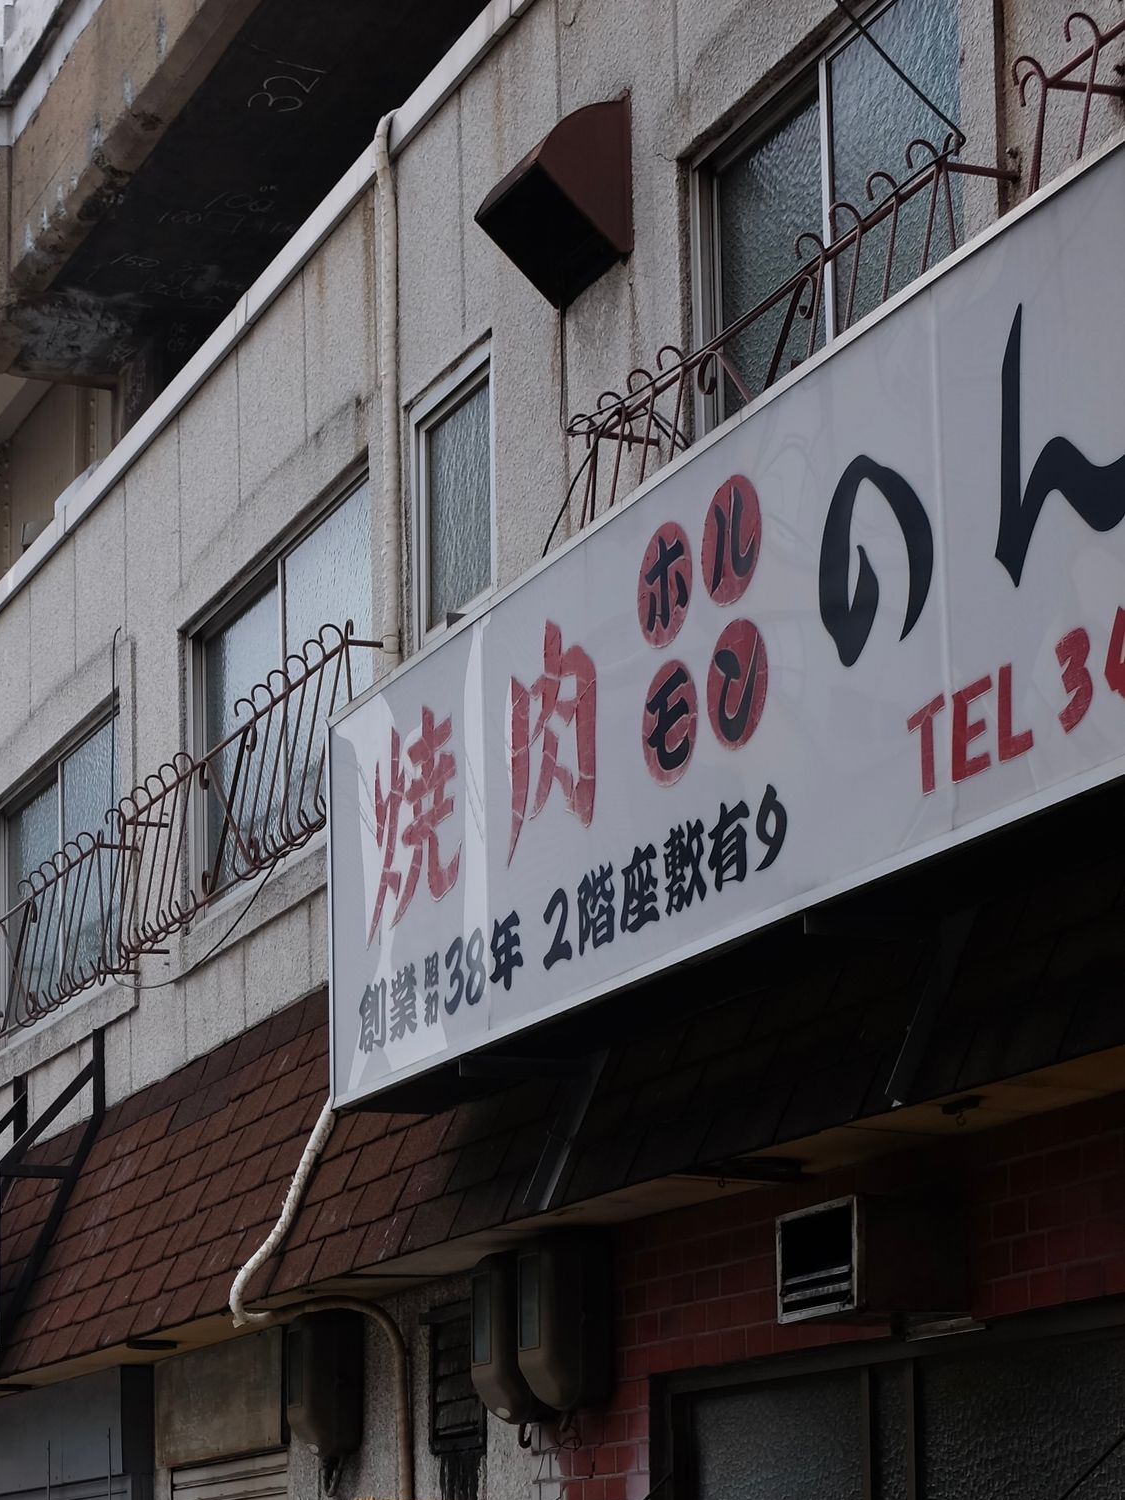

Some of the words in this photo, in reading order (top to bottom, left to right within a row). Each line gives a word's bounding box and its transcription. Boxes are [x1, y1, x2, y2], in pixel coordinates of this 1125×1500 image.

[365, 620, 598, 950] 焼肉
[907, 663, 1034, 796] TEL
[543, 784, 788, 970] 2階座敷有り
